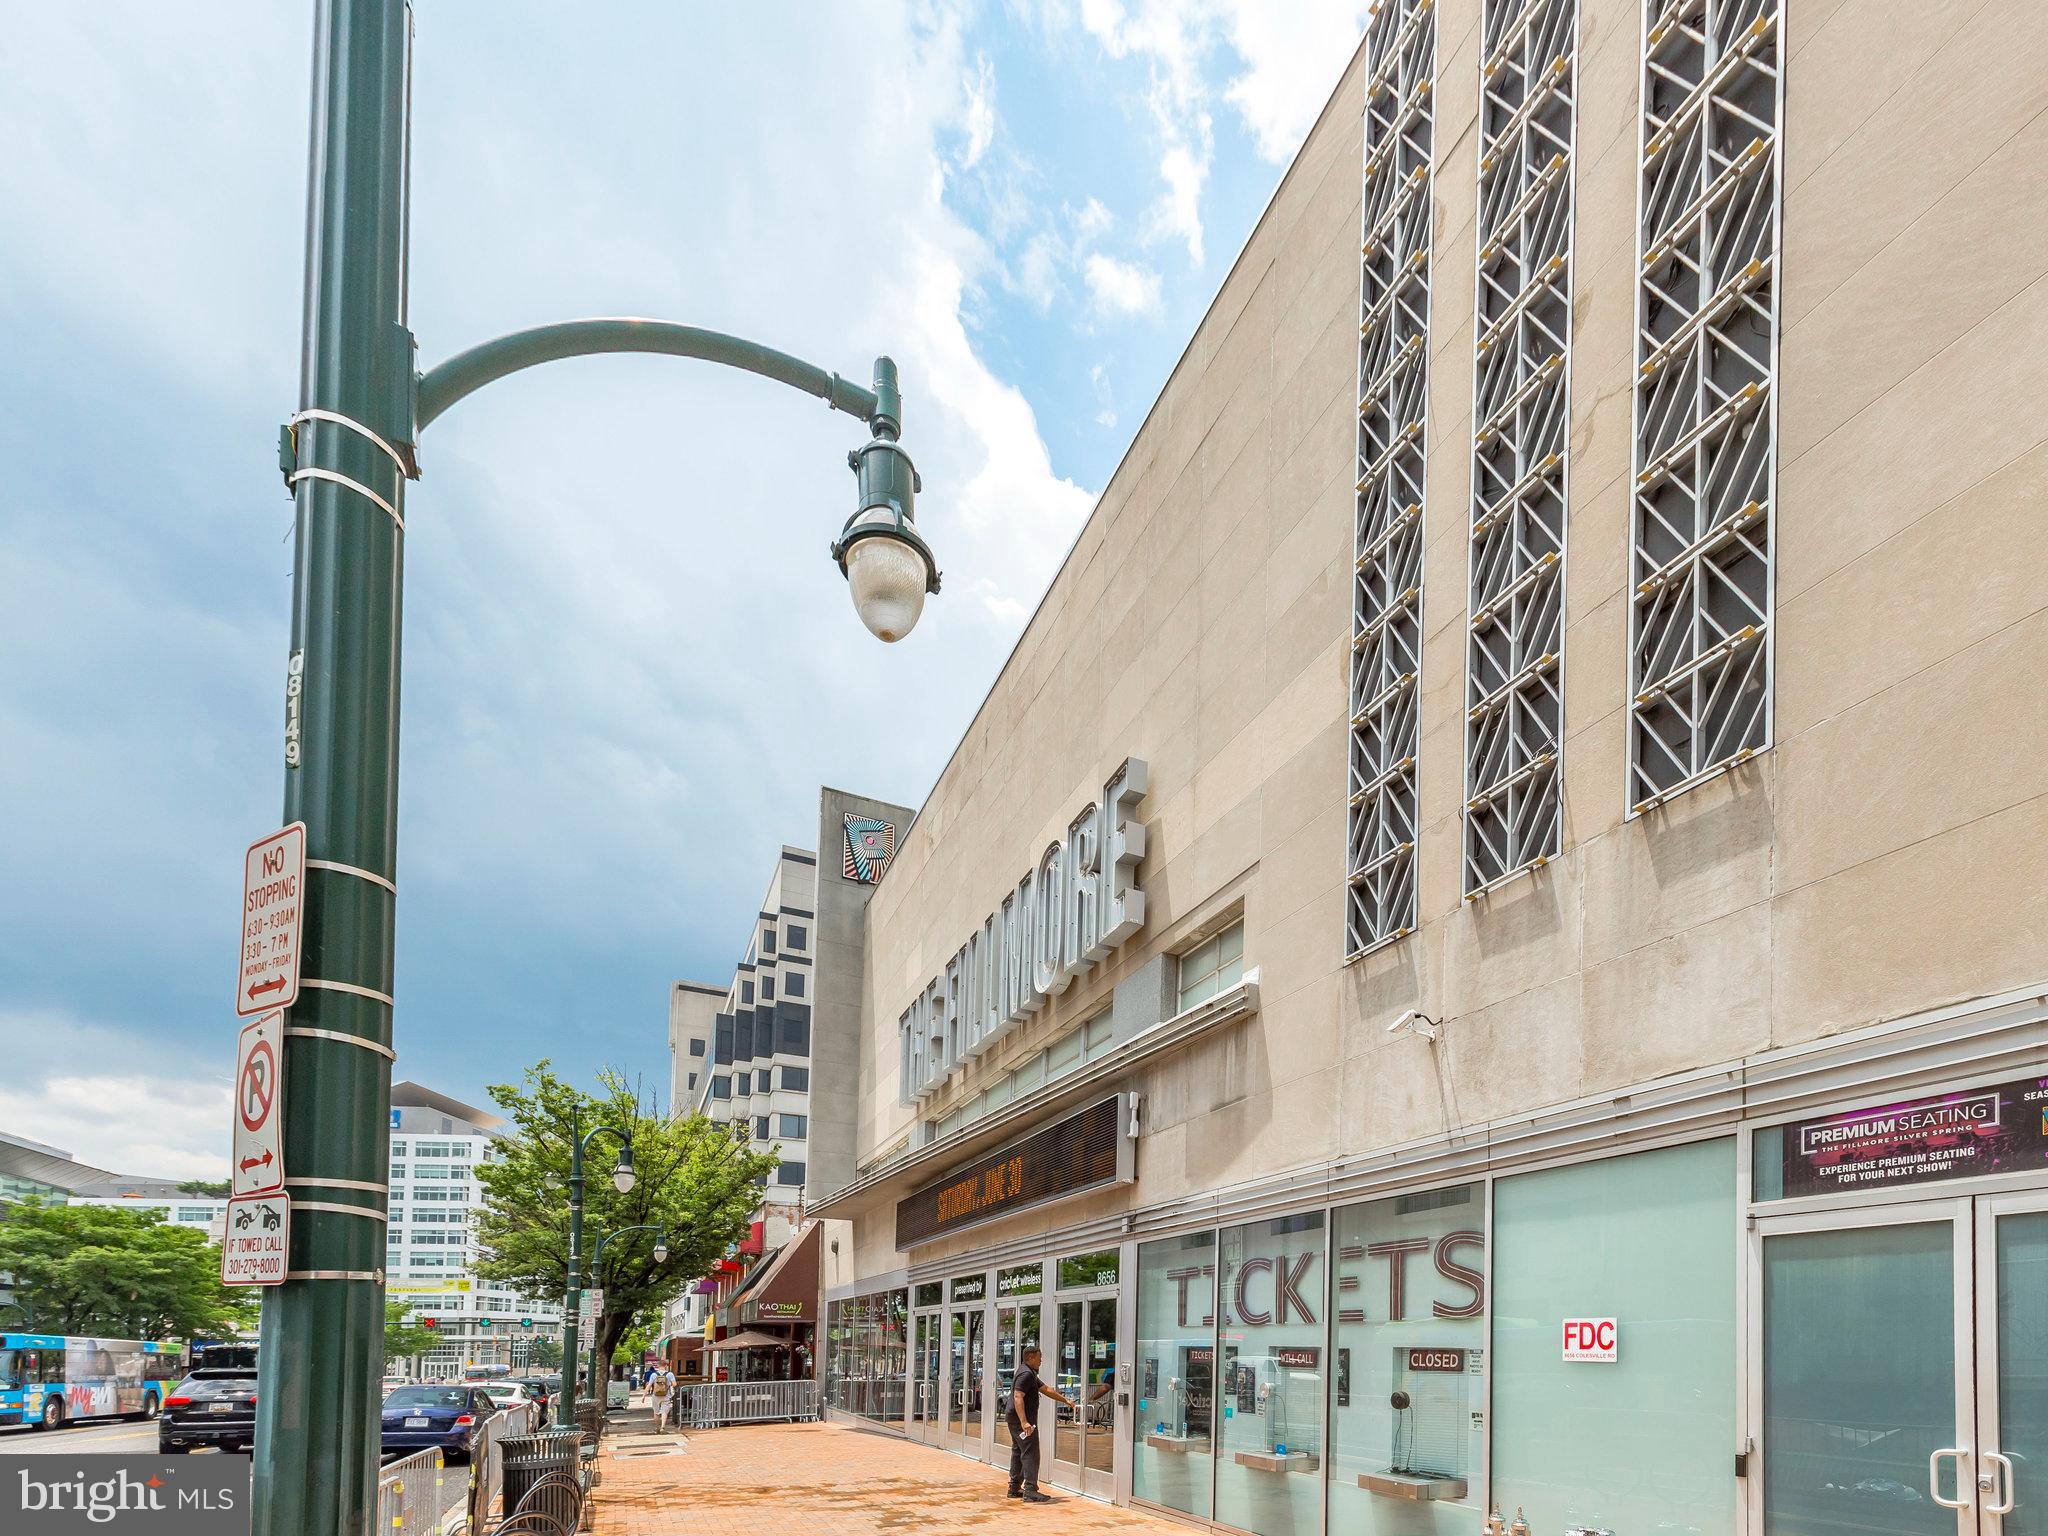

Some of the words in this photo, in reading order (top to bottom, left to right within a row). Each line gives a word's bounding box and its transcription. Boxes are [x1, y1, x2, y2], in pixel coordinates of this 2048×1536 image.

[285, 654, 304, 765] 08149
[263, 845, 285, 879] NO
[247, 875, 296, 912] STOPPING
[943, 756, 1148, 1075] FILLMORE
[1811, 1119, 1895, 1145] PREMIUM
[1899, 1103, 1987, 1131] SEATING
[1842, 1137, 1890, 1150] FILLMORE
[1894, 1131, 1928, 1142] SILVER
[1932, 1124, 1973, 1136] SPRING
[1819, 1160, 1876, 1176] EXPERIENCE
[1878, 1154, 1926, 1168] PREMIUM
[1929, 1147, 1975, 1162] SEATING
[1838, 1173, 1856, 1183] FOR
[1859, 1169, 1885, 1181] YOUR
[1887, 1166, 1914, 1178] NEXT
[1916, 1161, 1952, 1174] SHOW!
[229, 1239, 236, 1253] IF
[238, 1237, 262, 1253] TOWED
[265, 1236, 283, 1252] CALL
[228, 1257, 280, 1275] 301-279-8000
[1096, 1270, 1116, 1286] 8656
[976, 1280, 983, 1294] by
[1000, 1274, 1019, 1291] cricket
[1564, 1321, 1615, 1350] FDC
[1411, 1353, 1459, 1368] CLOSED
